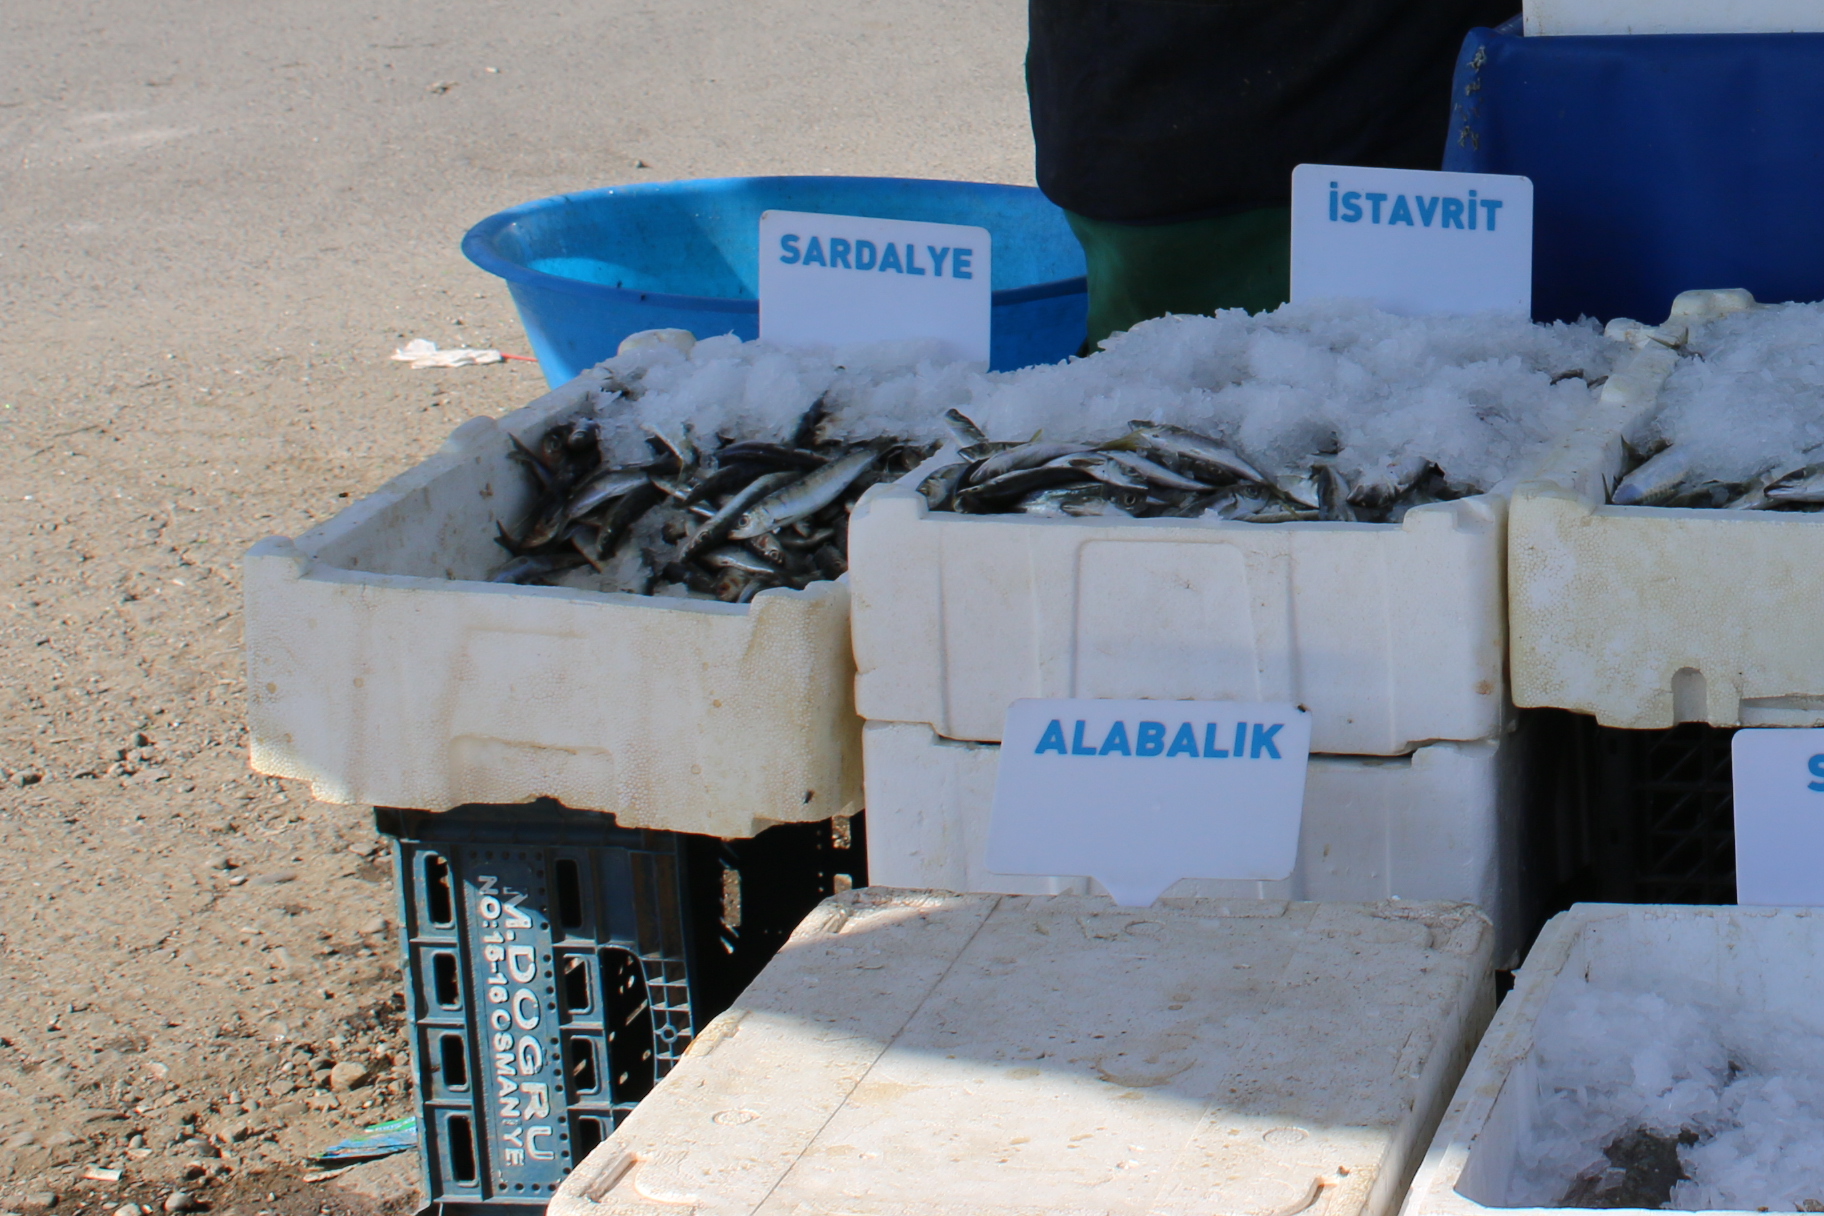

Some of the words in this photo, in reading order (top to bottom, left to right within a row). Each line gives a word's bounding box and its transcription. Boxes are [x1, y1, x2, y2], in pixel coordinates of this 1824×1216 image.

[1328, 181, 1503, 232] İSTAVRİT
[779, 234, 973, 280] SARDALYE
[1033, 719, 1285, 759] ALABALIK
